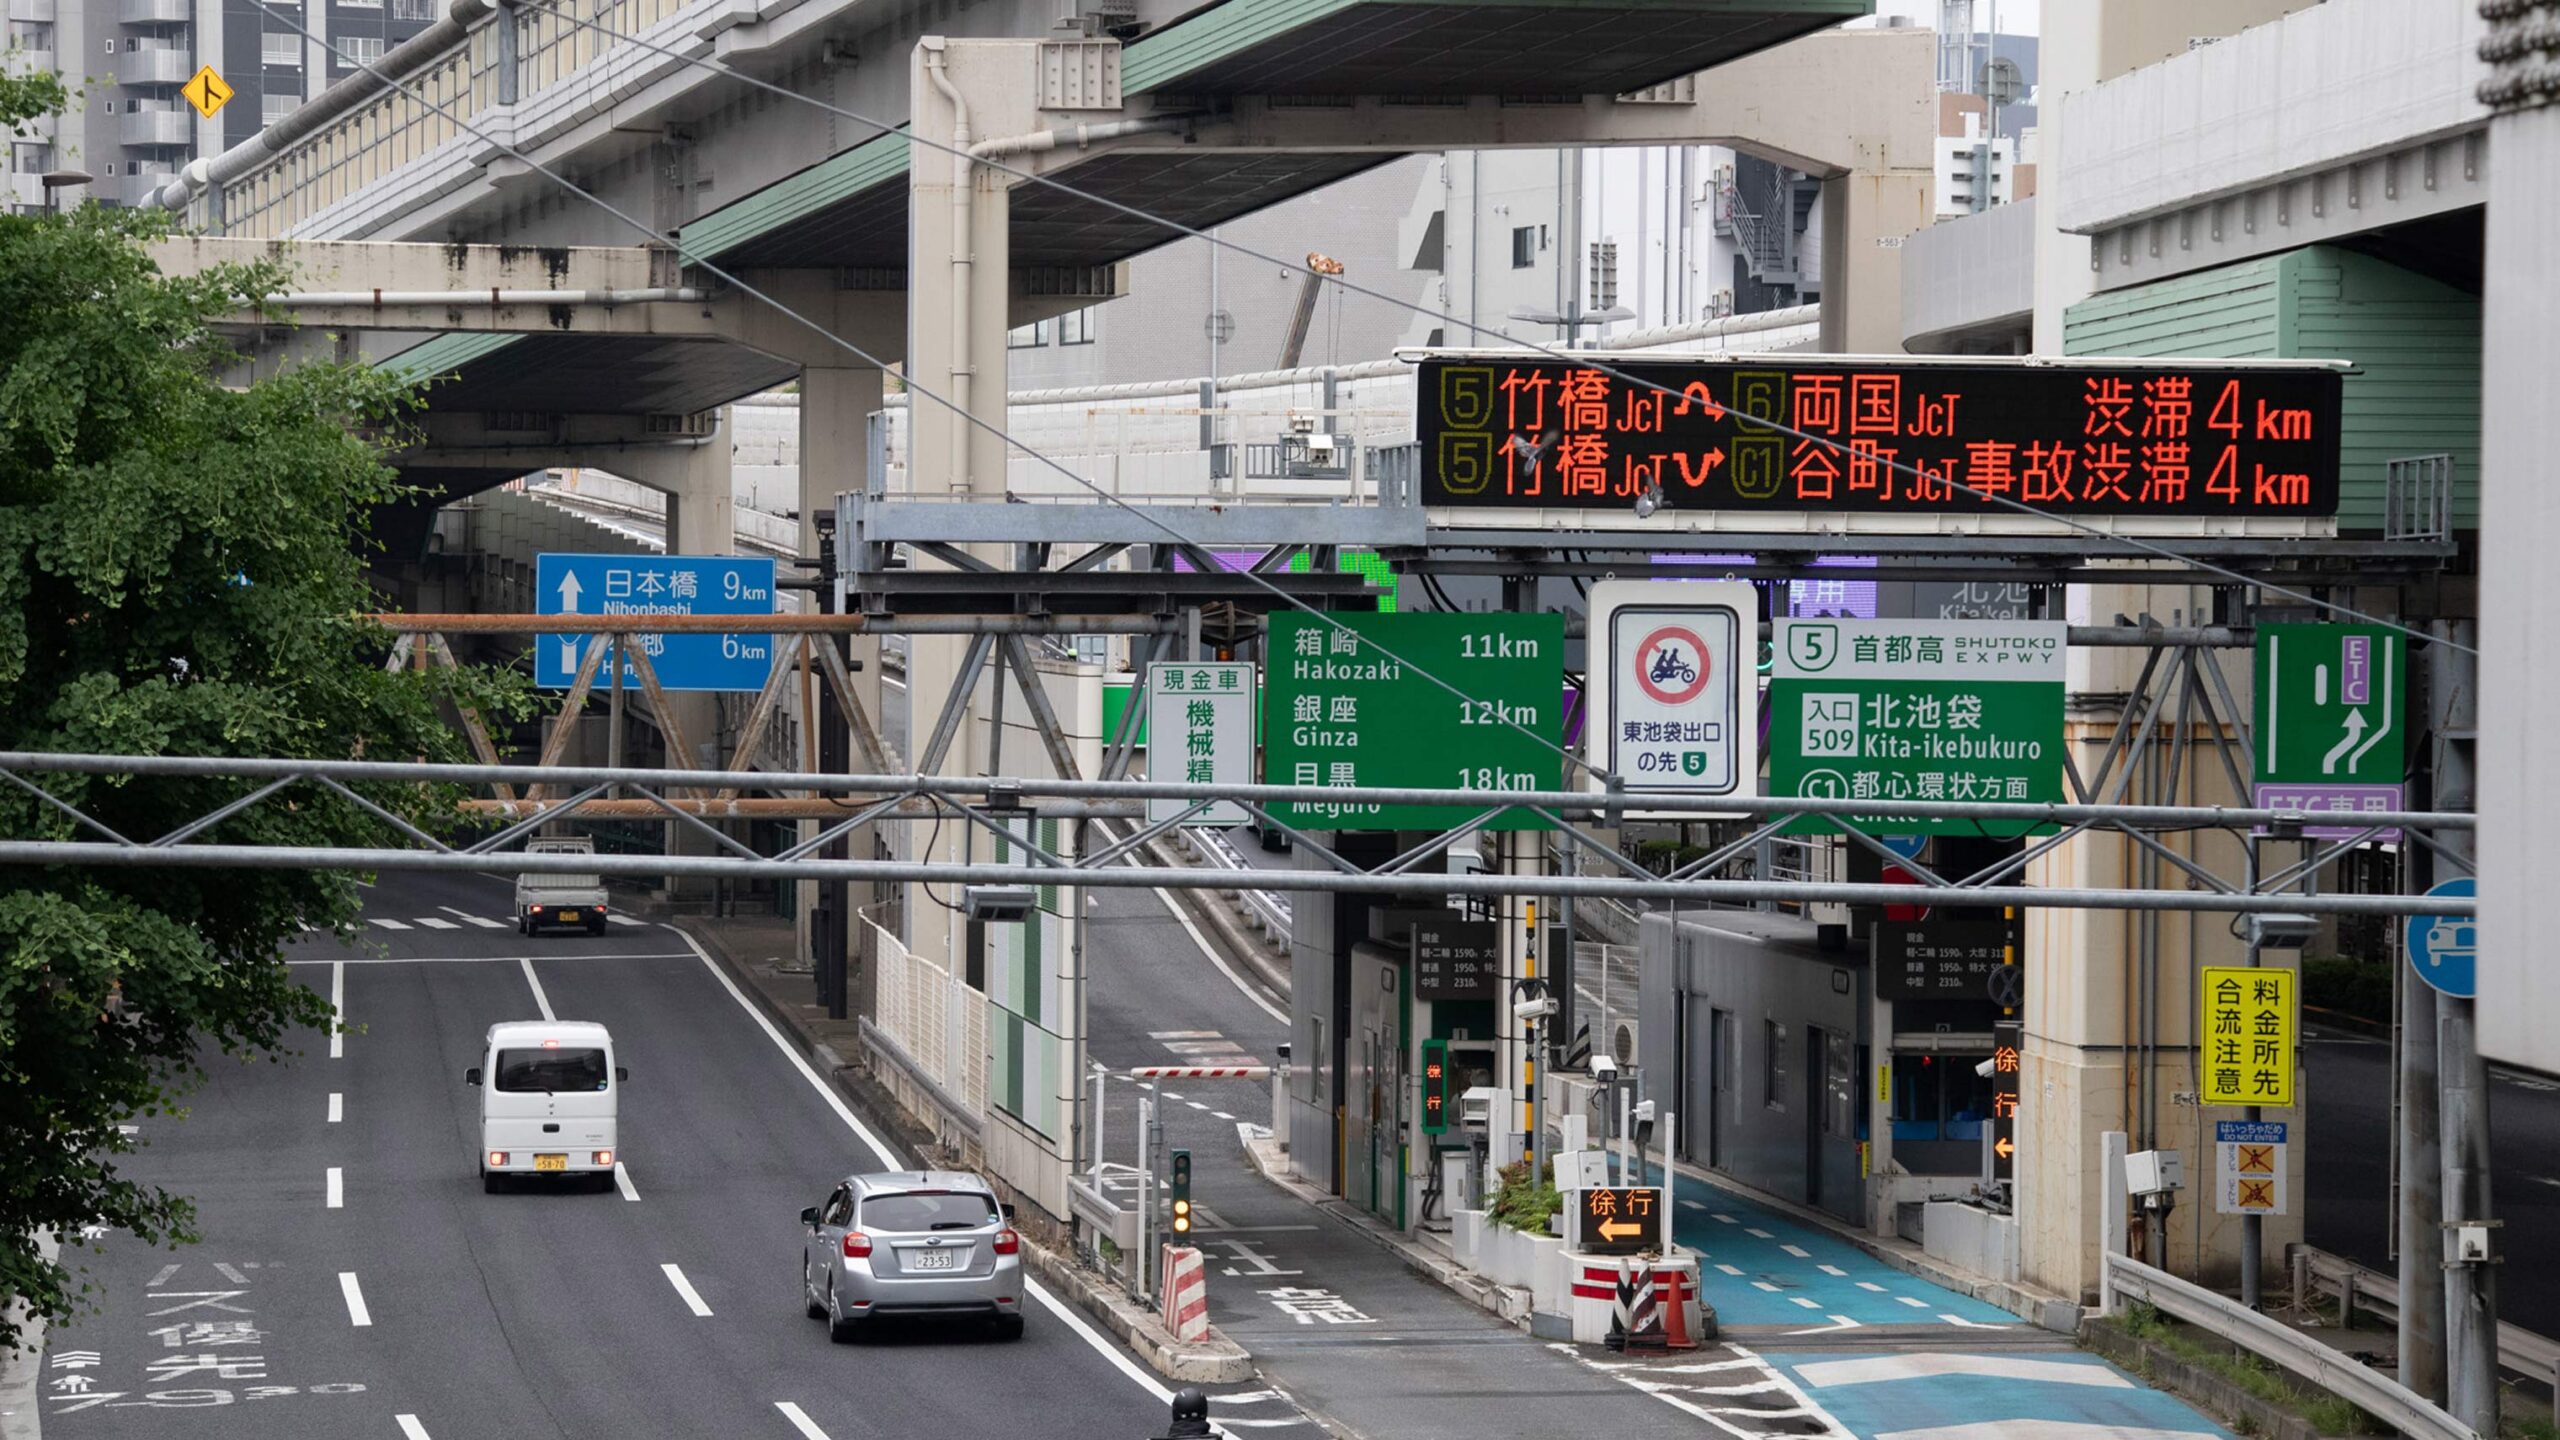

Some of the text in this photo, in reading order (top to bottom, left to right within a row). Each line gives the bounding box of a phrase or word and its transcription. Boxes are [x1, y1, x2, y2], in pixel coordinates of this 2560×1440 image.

[1454, 377, 1479, 418] 5
[1750, 383, 1772, 422] 6
[2083, 376, 2193, 439] 渋滞
[1454, 441, 1478, 483] 5
[1739, 449, 1771, 489] C1
[606, 569, 698, 599] 日本橋
[603, 601, 691, 615] Nihonbashi
[1805, 632, 1823, 660] 5
[1852, 634, 1944, 664] 首都高
[1954, 637, 2057, 650] SHUTOKO
[1163, 669, 1239, 691] 現金車
[1294, 660, 1400, 680] Hakozaki
[2348, 640, 2363, 700] ETC
[1293, 696, 1358, 724] 銀座
[1808, 700, 1853, 722] 入口
[1865, 694, 1983, 730] 北池袋
[1294, 727, 1359, 748] Ginza
[1623, 721, 1721, 743] 東池袋出口
[1808, 729, 1854, 751] 509
[1864, 732, 2042, 760] Kita-ikebukuro
[1186, 698, 1215, 816] 機械精
[1637, 751, 1678, 773] の先
[1294, 762, 1357, 788] 目黒
[1807, 779, 1836, 799] C1
[2215, 978, 2242, 1095] 合流注意
[2253, 979, 2280, 1096] 料金所先
[1995, 1046, 2019, 1118] 徐行
[2255, 1134, 2279, 1142] ENTER
[1590, 1188, 1653, 1216] 徐行
[923, 1257, 950, 1267] 23-53
